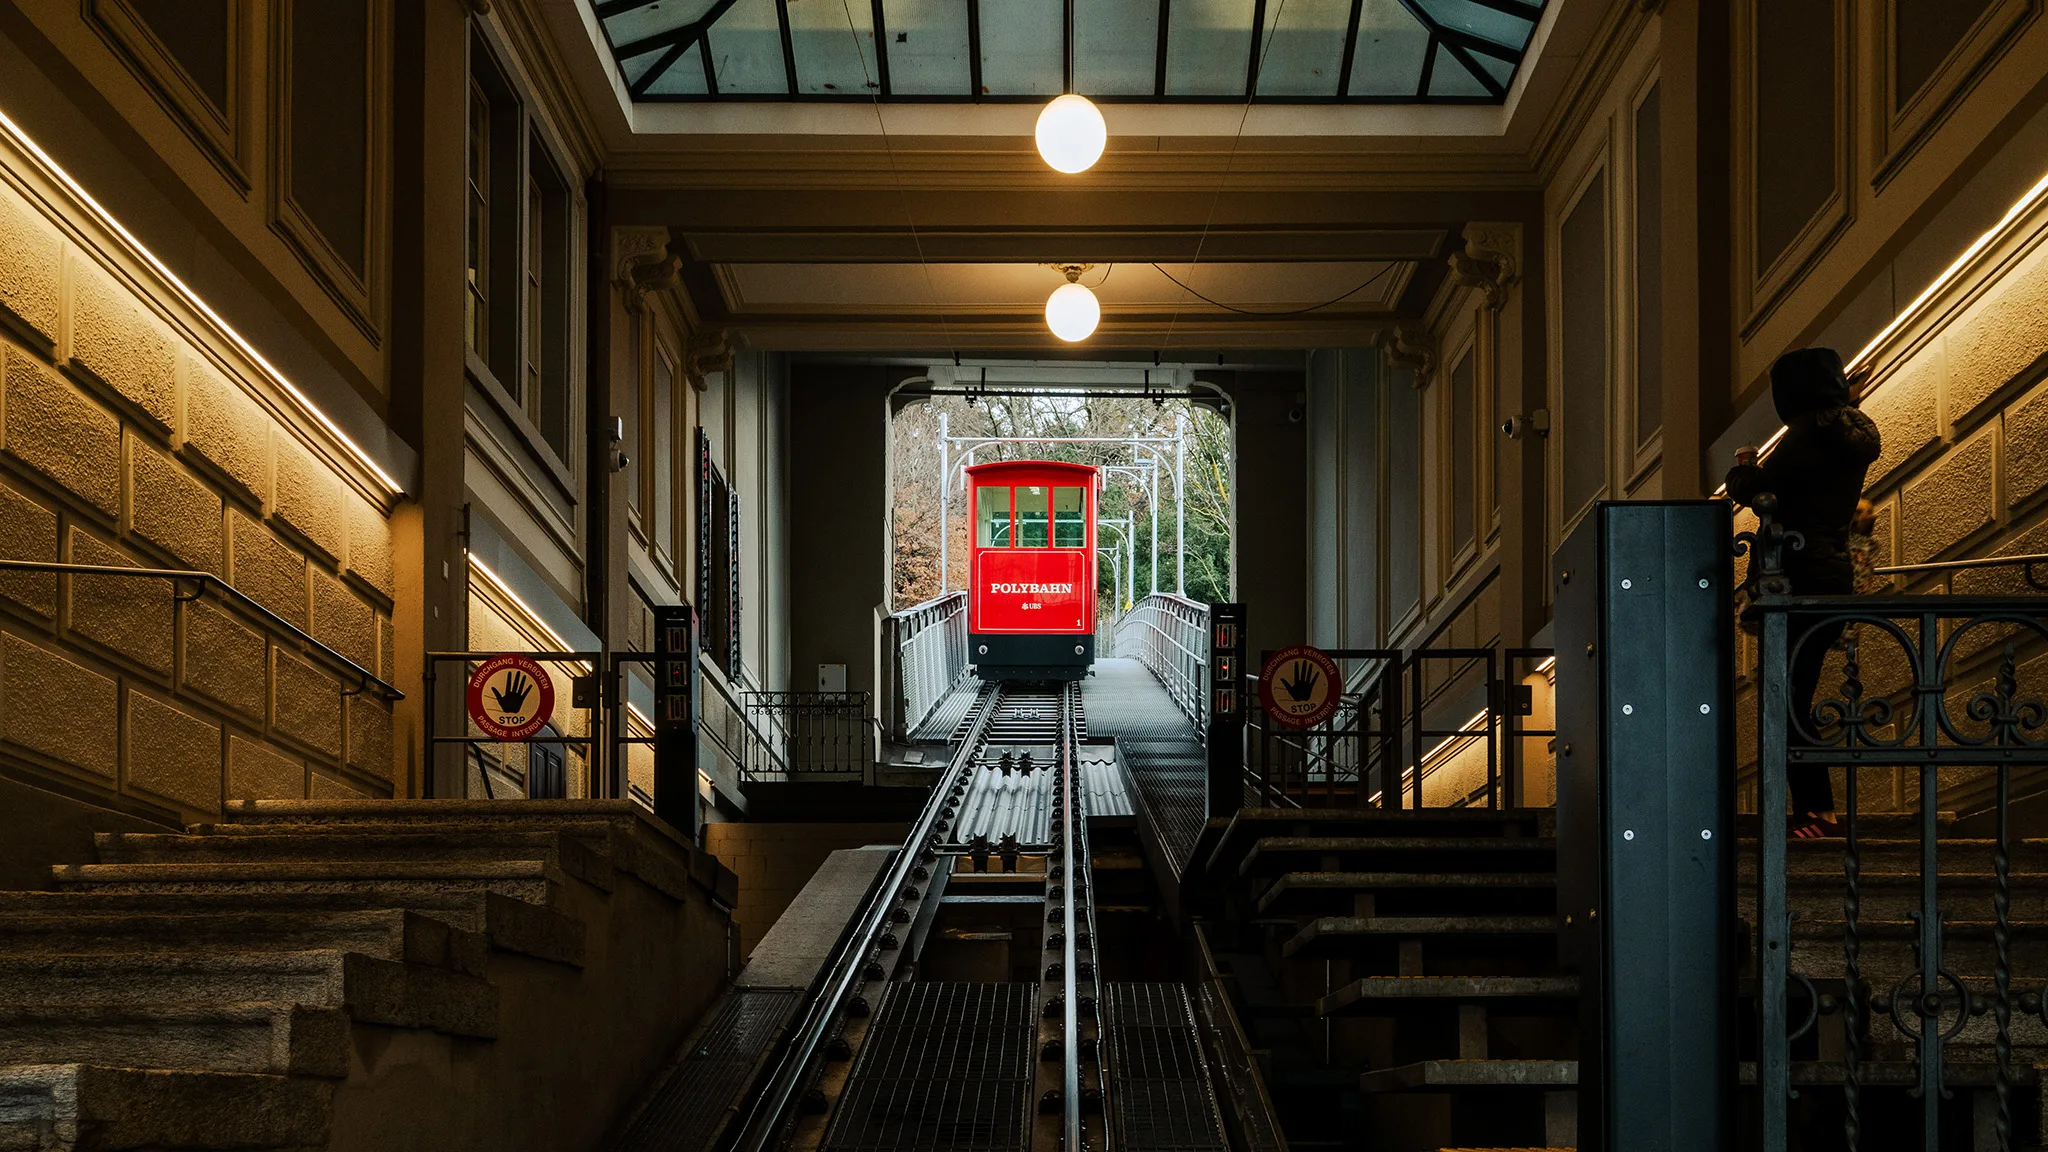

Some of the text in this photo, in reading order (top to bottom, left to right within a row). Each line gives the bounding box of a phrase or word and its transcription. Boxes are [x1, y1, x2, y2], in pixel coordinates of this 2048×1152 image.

[991, 583, 1073, 594] POLYBAHN
[473, 658, 549, 689] DURCHGANG VERBOTEN
[1263, 648, 1336, 681] DURCHGANG VERBOTEN
[1270, 702, 1334, 725] PASSAGE INTERDIT
[1290, 703, 1317, 713] STOP
[477, 715, 544, 737] PASSAGE INTERDIT
[498, 716, 526, 724] STOP
